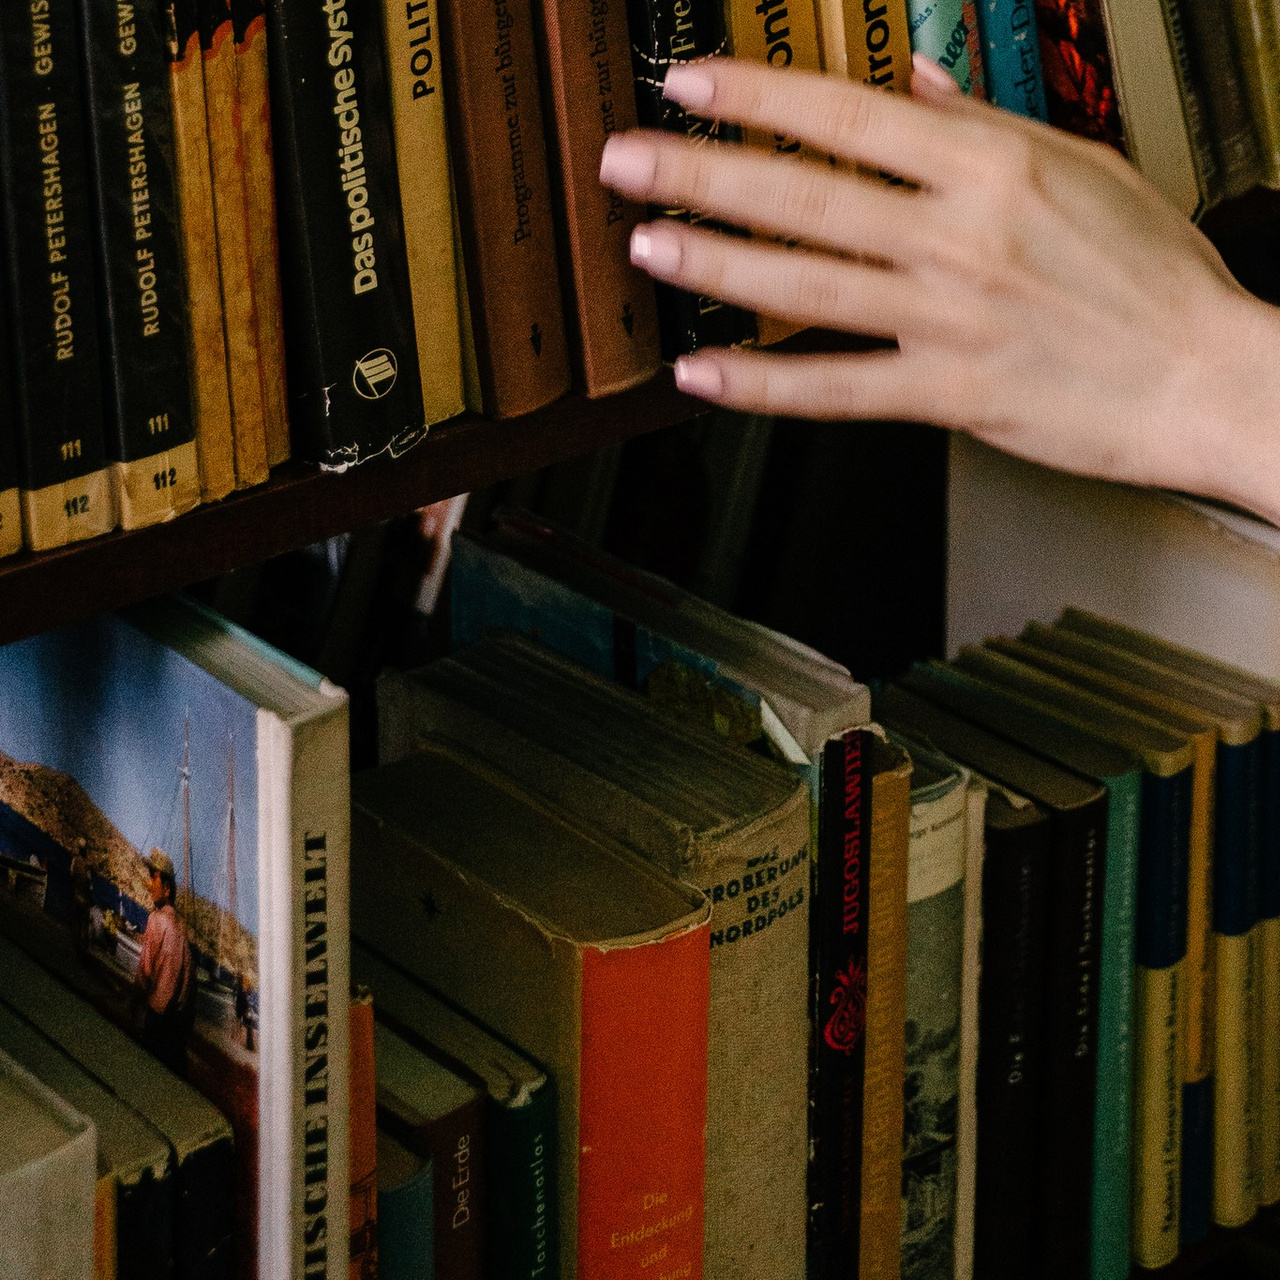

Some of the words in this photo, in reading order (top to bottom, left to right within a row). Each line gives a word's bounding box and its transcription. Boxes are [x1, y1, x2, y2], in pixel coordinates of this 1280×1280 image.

[499, 72, 519, 112] zur
[596, 59, 615, 96] zur
[122, 82, 154, 241] PETERSHAGEN
[333, 67, 377, 230] politische
[38, 102, 69, 264] PETERSHAGEN
[504, 114, 534, 245] Programme
[350, 231, 379, 296] Das
[51, 269, 76, 361] RUDOLF
[136, 246, 162, 338] RUDOLF
[152, 466, 179, 491] 112
[745, 889, 782, 915] DES
[303, 829, 329, 1108] INSELWELT
[451, 1133, 472, 1189] Erde
[452, 1189, 472, 1230] Die
[610, 1203, 695, 1249] Entdeckung
[642, 1190, 669, 1212] Die
[640, 1243, 670, 1269] und
